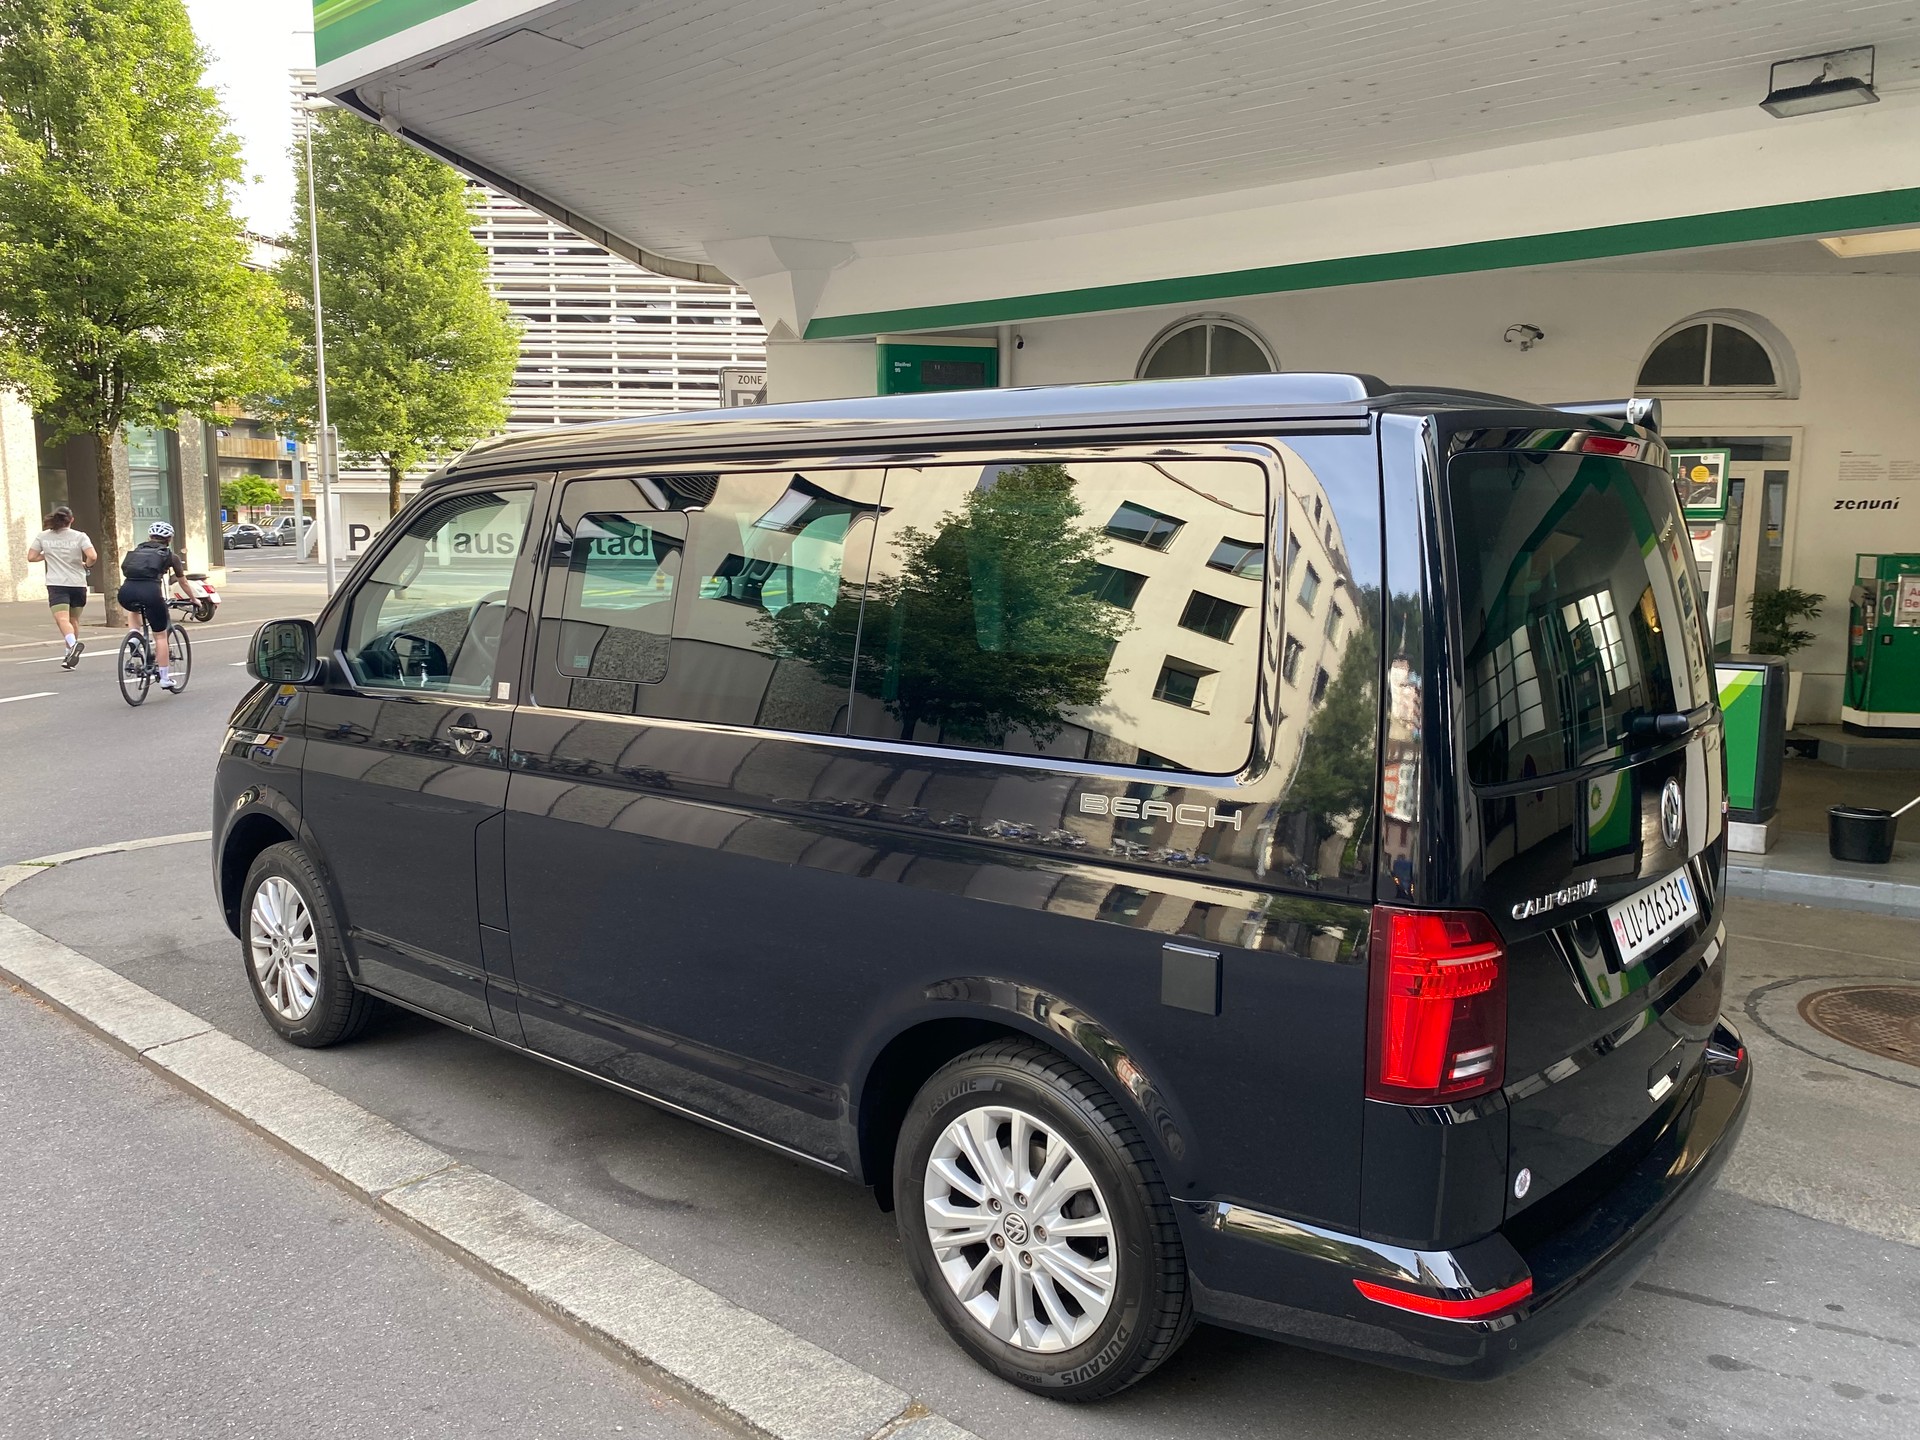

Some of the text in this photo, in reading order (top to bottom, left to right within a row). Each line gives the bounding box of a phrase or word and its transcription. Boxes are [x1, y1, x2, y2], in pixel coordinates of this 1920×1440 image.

[738, 375, 763, 385] ZONE
[1833, 496, 1902, 510] zenuni
[1079, 792, 1242, 831] BEACH
[1511, 878, 1599, 921] CALIFORNIA
[1060, 1324, 1131, 1386] DURAVIS
